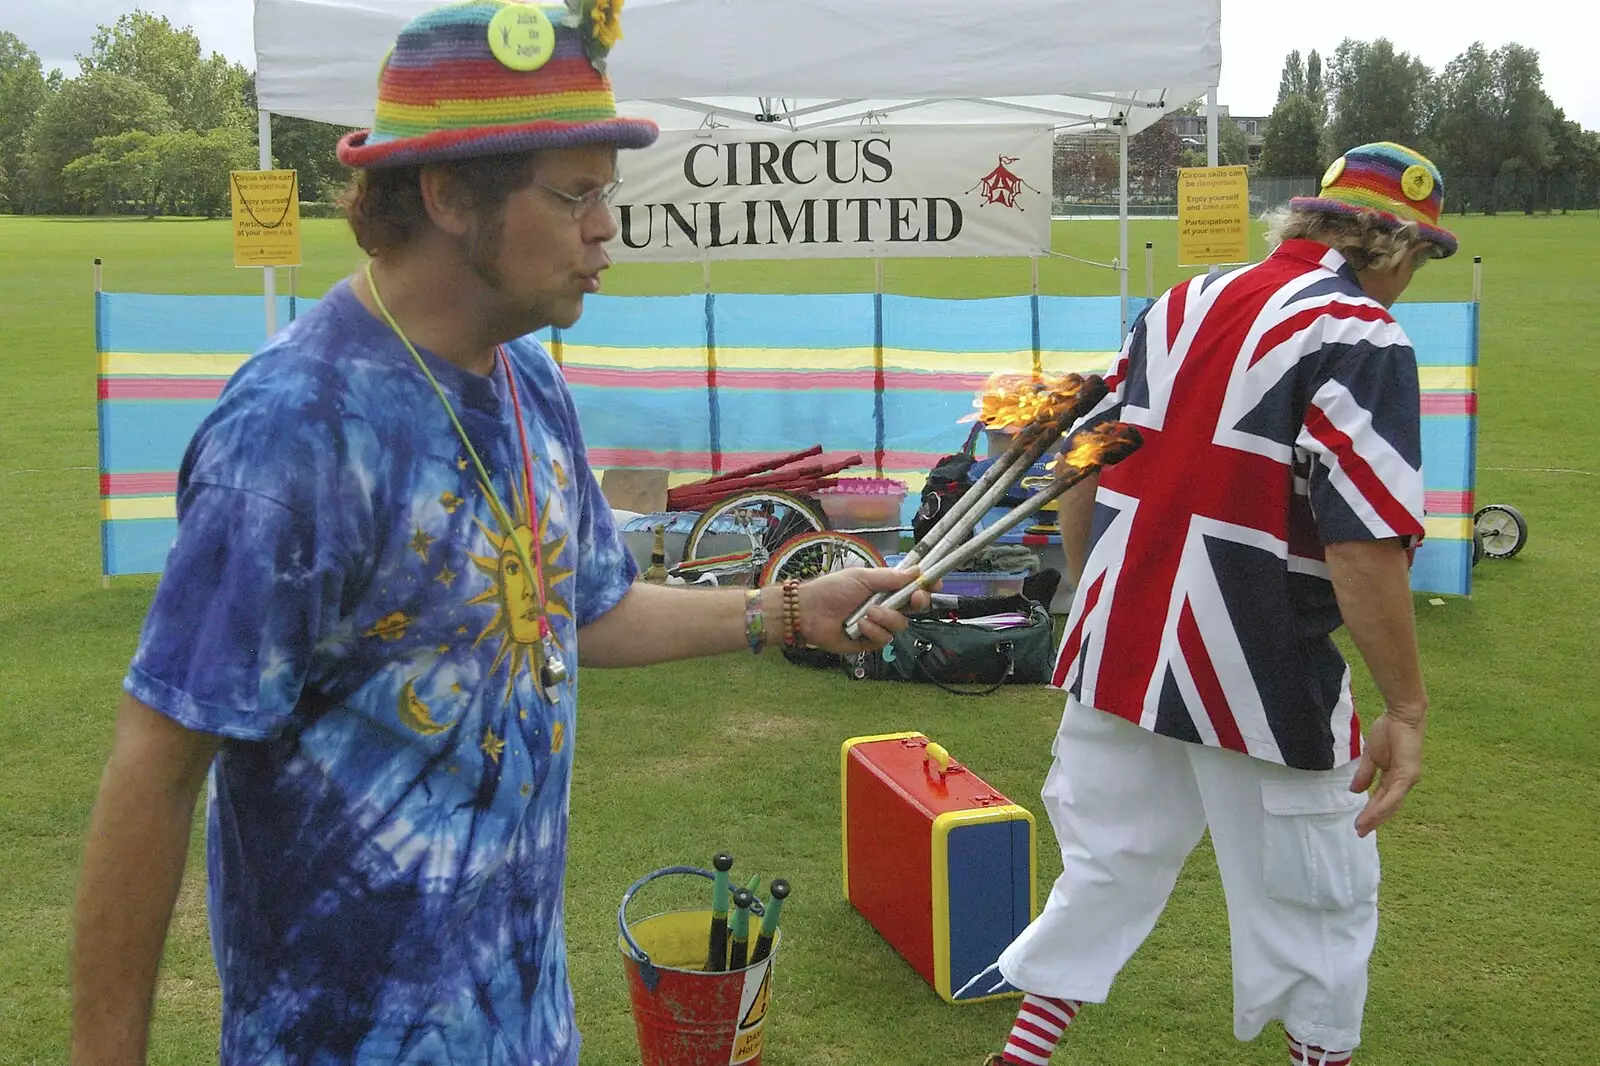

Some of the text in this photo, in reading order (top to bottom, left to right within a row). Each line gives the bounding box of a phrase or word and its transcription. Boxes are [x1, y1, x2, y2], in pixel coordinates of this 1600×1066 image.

[683, 138, 893, 189] CIRCUS
[1187, 194, 1239, 203] Enjoy yourself
[615, 197, 964, 249] UNLIMITED
[1185, 218, 1232, 227] Participation
[746, 1031, 760, 1044] DAN
